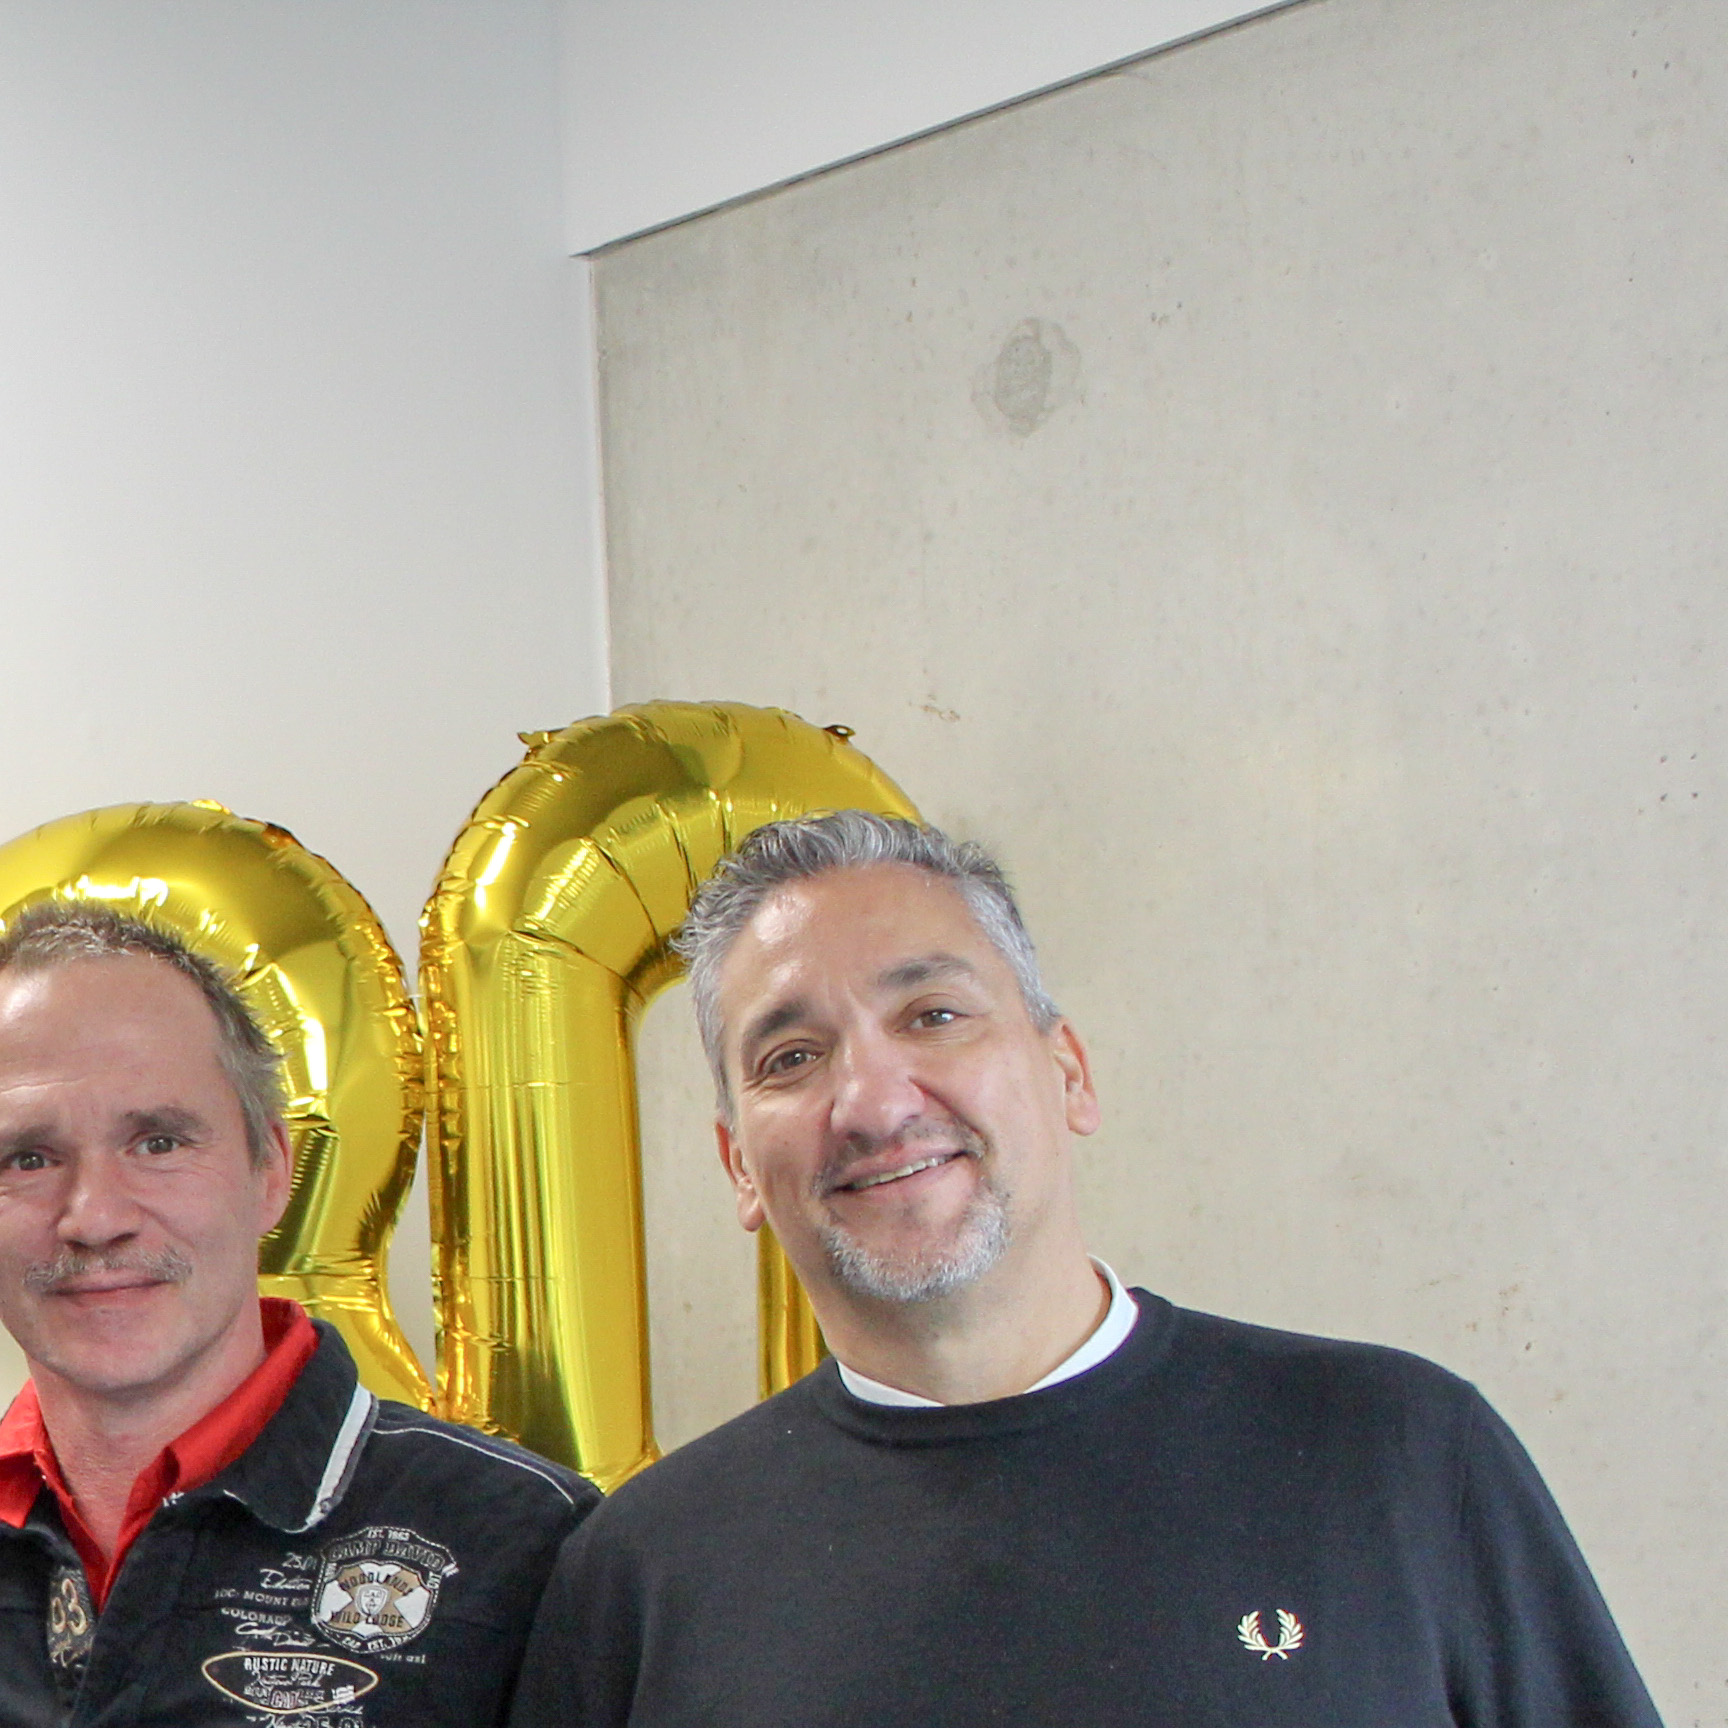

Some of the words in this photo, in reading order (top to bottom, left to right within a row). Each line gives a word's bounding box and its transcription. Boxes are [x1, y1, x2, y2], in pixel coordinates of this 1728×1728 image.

[328, 1540, 381, 1562] CAMP
[382, 1541, 446, 1572] DAVID
[244, 1657, 288, 1672] RUSTIC
[291, 1658, 336, 1676] NATURE
